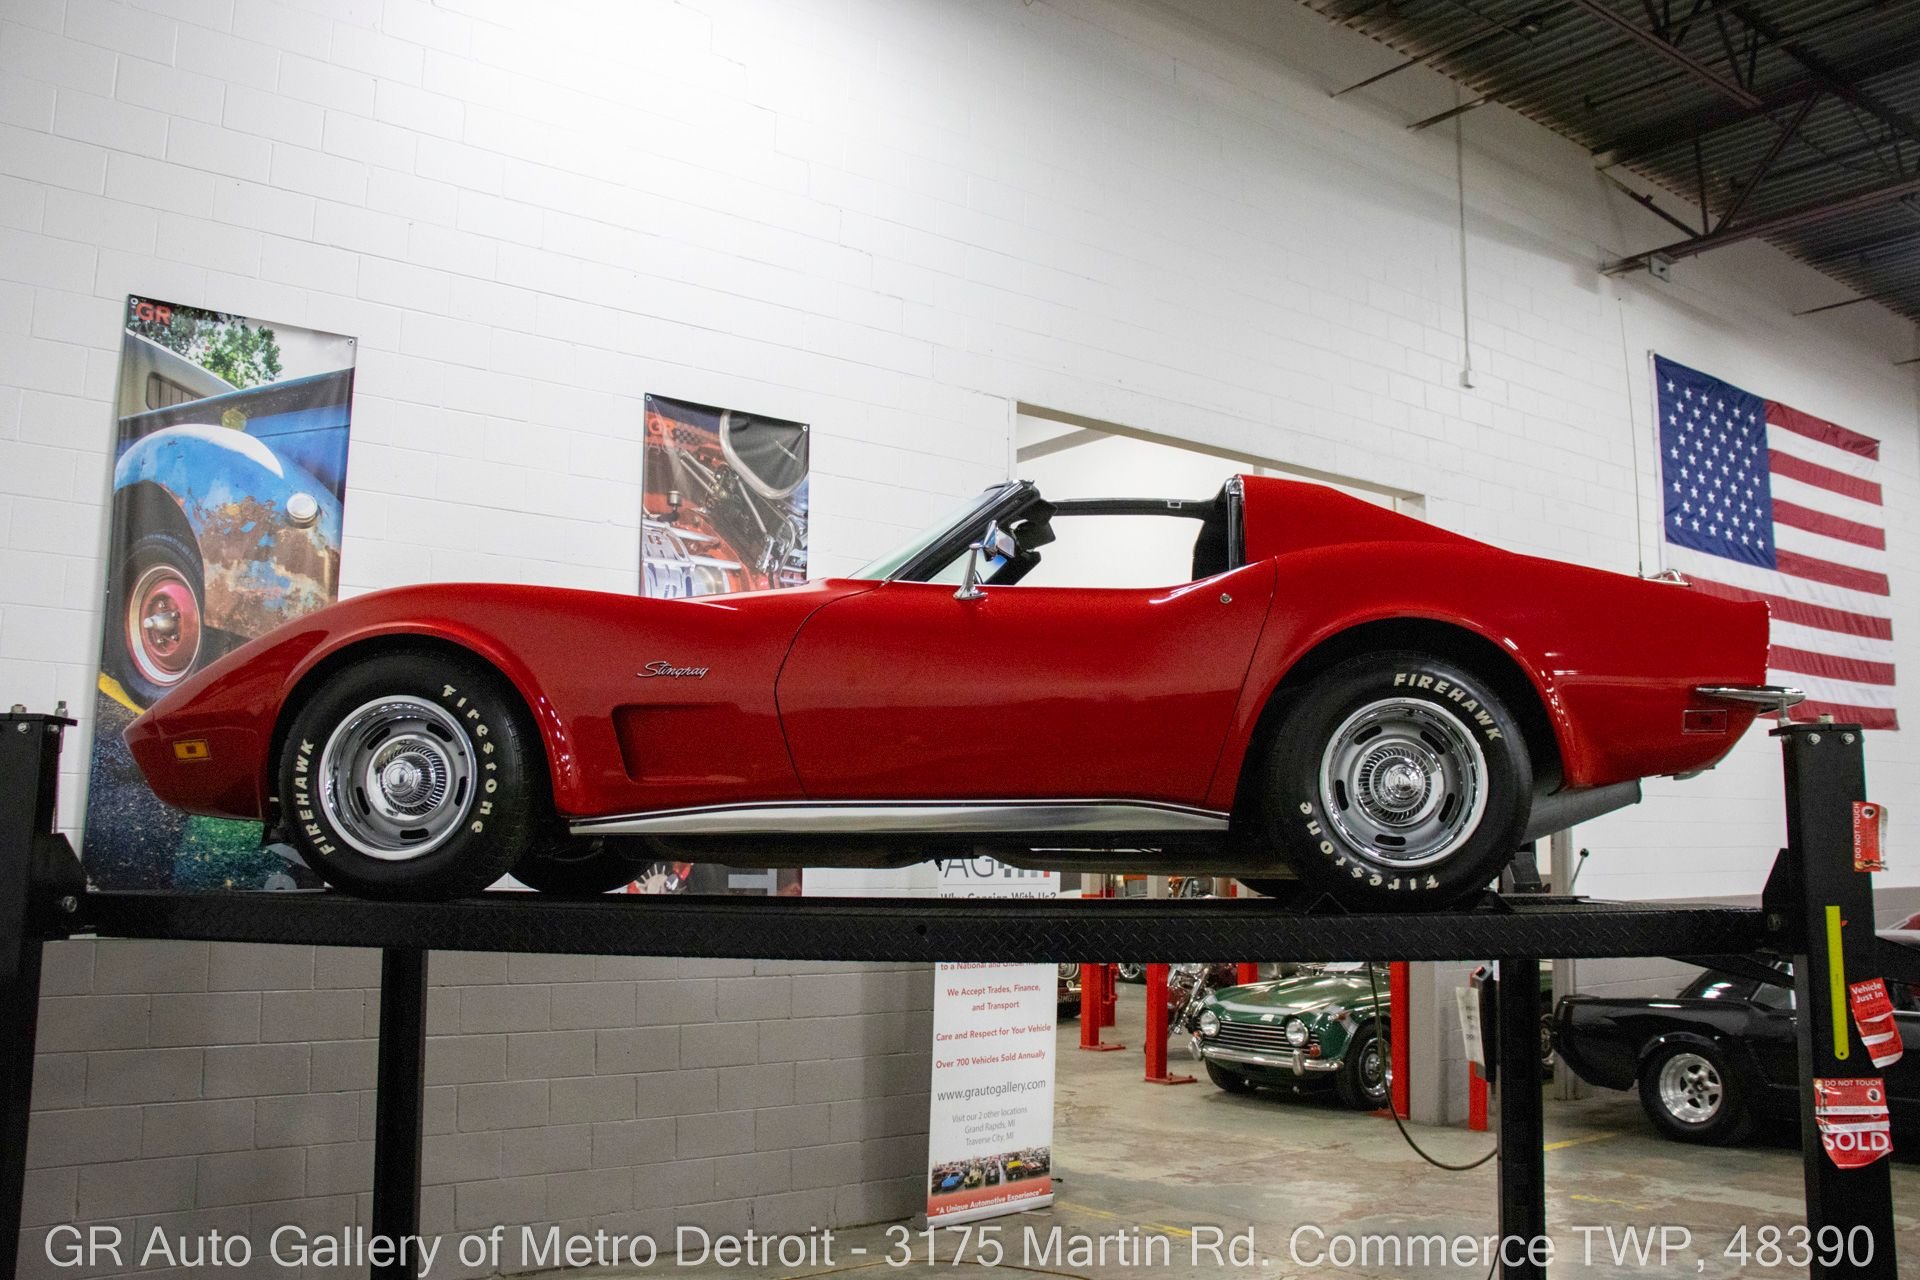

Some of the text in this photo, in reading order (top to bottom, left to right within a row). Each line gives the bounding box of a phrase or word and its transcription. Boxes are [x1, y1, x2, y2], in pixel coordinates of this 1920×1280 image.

[135, 302, 171, 325] GR
[637, 661, 709, 679] Stingray
[1394, 673, 1503, 741] FIREHAWK
[442, 684, 497, 833] Firestone
[294, 739, 336, 856] FIREHAWK
[1300, 801, 1439, 890] Firestone
[1855, 848, 1861, 859] DO
[957, 962, 986, 970] National
[947, 988, 959, 996] We
[961, 987, 985, 997] Accept
[1014, 983, 1041, 993] Finance,
[1851, 982, 1882, 994] Vehicle
[1856, 990, 1884, 1003] Just In
[972, 1001, 1020, 1011] and Transport
[936, 1024, 1051, 1041] Care and Respect for Your Vehicle
[936, 1049, 1046, 1069] Over 700 Vehicles Sold Annually
[937, 1078, 1046, 1101] www.grautogallery.com
[952, 1113, 965, 1123] Visit
[966, 1113, 977, 1121] our
[984, 1109, 1000, 1119] other
[1001, 1106, 1028, 1117] locations
[964, 1124, 984, 1135] Grand
[966, 1136, 991, 1146] Traverse
[1823, 1132, 1889, 1151] SOLD
[946, 1203, 969, 1214] Unique
[970, 1196, 1006, 1209] Automotive
